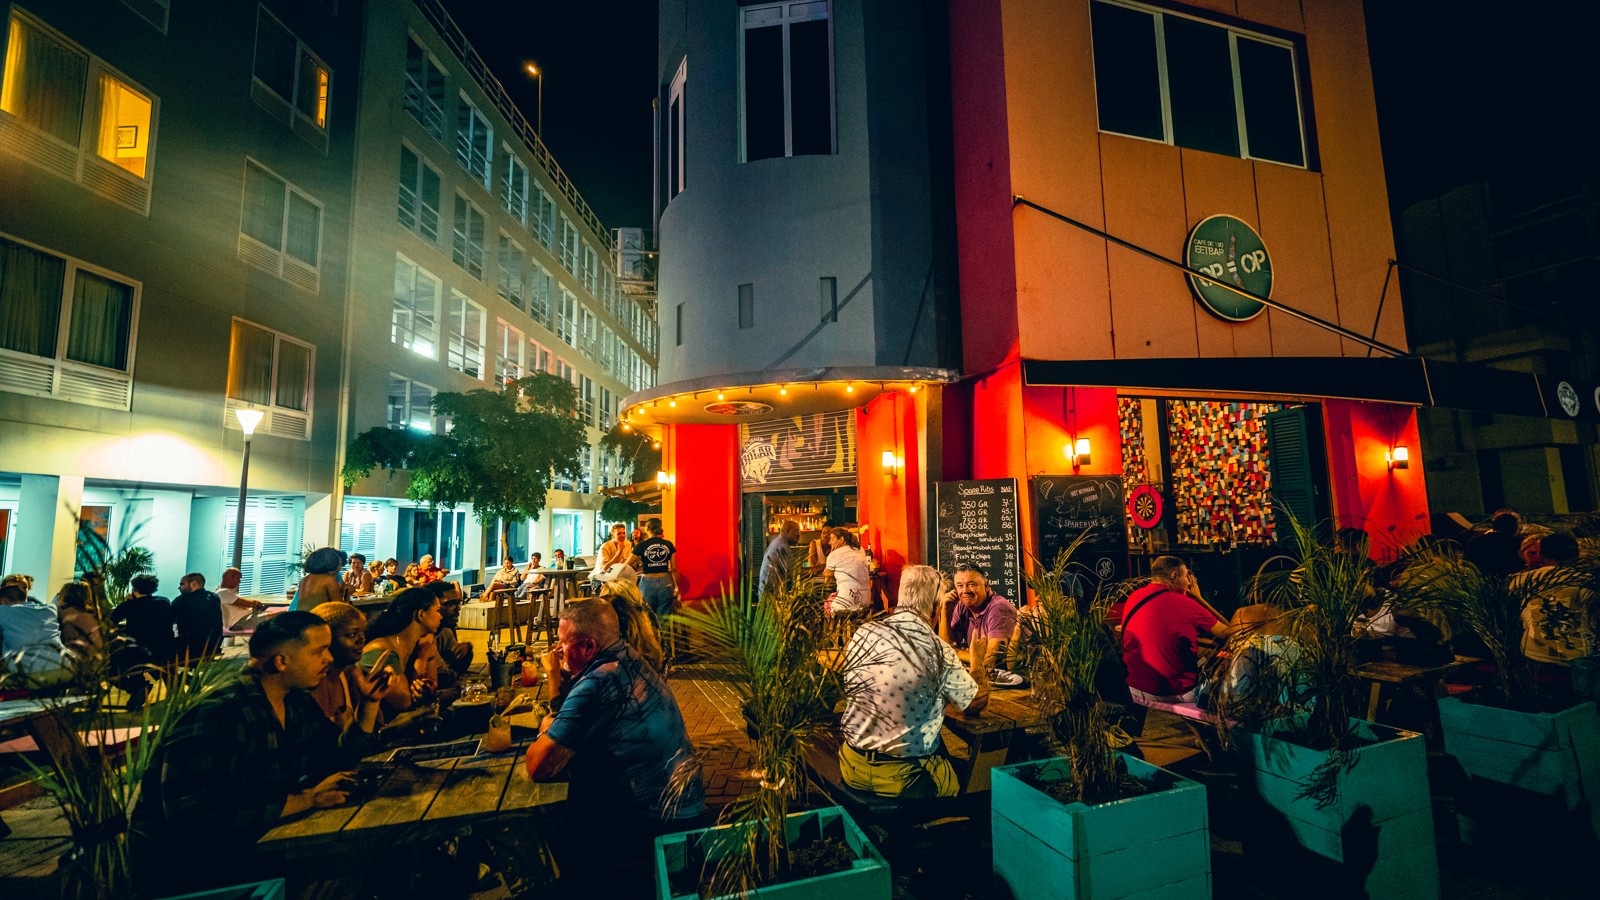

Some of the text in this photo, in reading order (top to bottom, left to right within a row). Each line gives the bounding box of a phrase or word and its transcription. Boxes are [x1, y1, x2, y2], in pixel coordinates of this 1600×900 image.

[1194, 245, 1224, 256] EETBAR
[1198, 263, 1224, 287] OP
[1241, 250, 1266, 273] OP
[961, 500, 976, 509] 350
[978, 500, 988, 508] GR
[961, 510, 976, 518] 500
[1064, 519, 1098, 528] SPARERIBS
